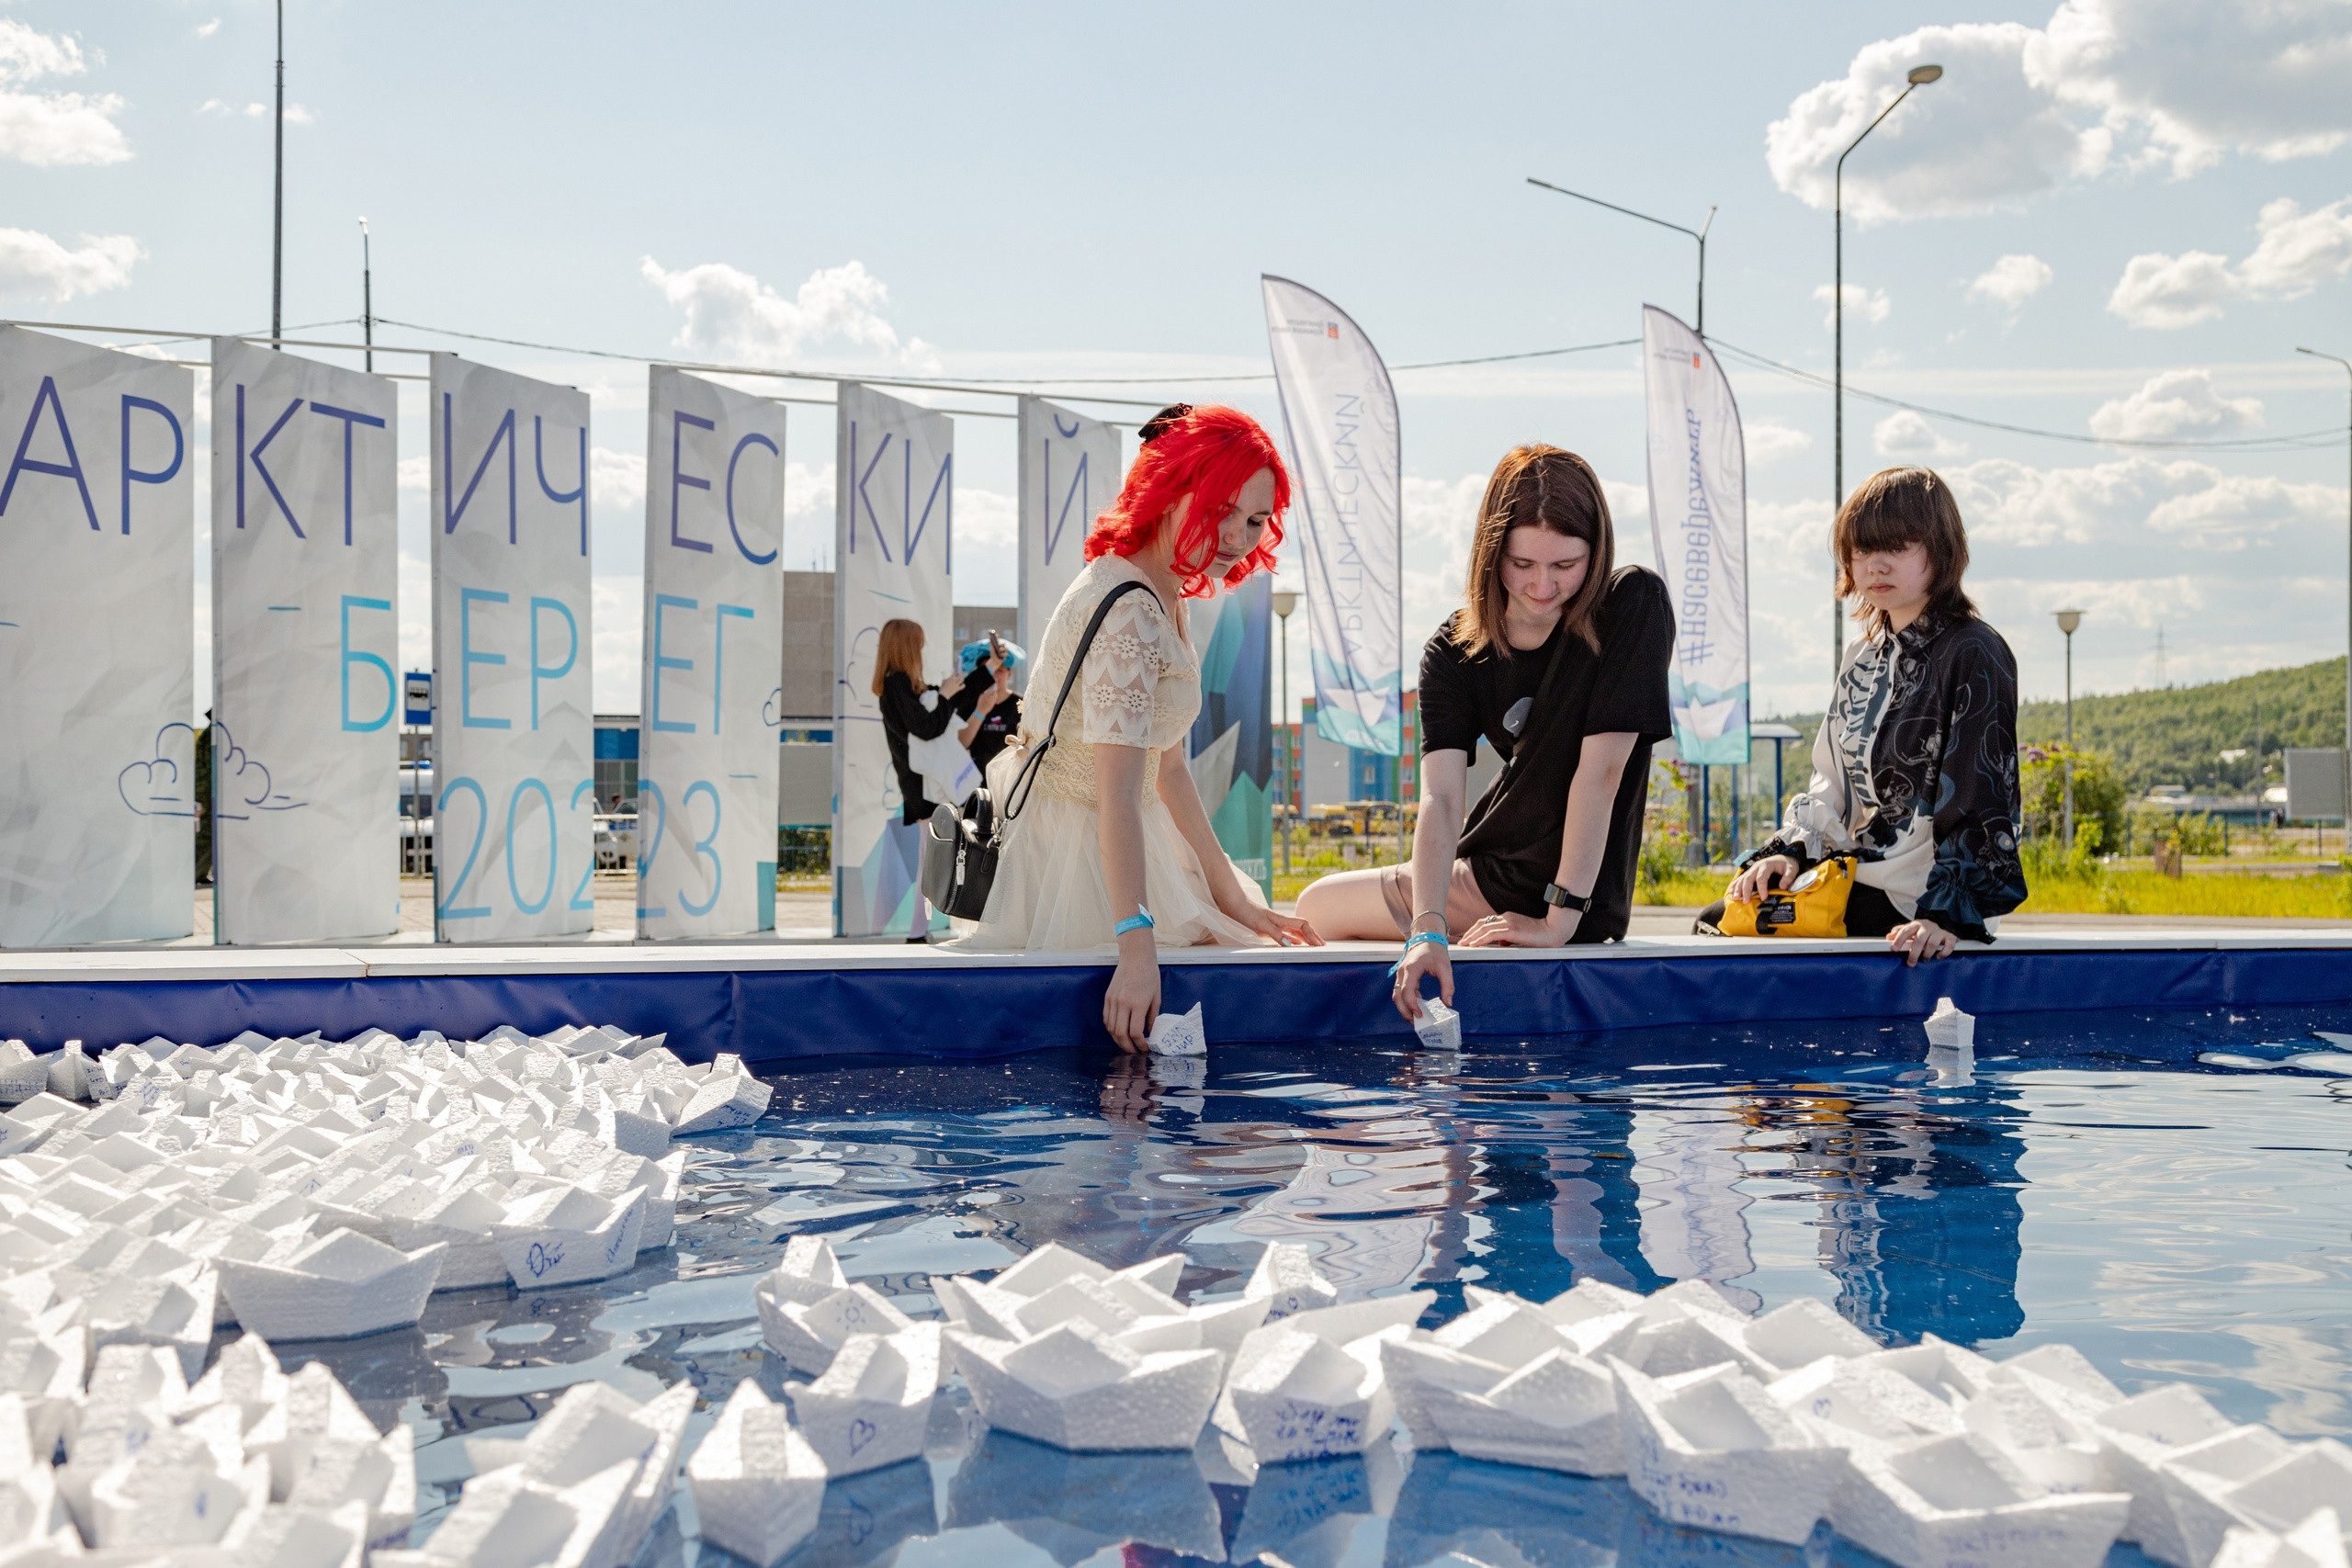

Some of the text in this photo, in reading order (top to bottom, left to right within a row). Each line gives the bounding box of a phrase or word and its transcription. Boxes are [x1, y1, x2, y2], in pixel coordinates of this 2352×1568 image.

[0, 375, 1088, 575] АРКТИЧЕСКИЙ
[341, 587, 754, 736] БЕРЕГ
[436, 776, 722, 919] 2023
